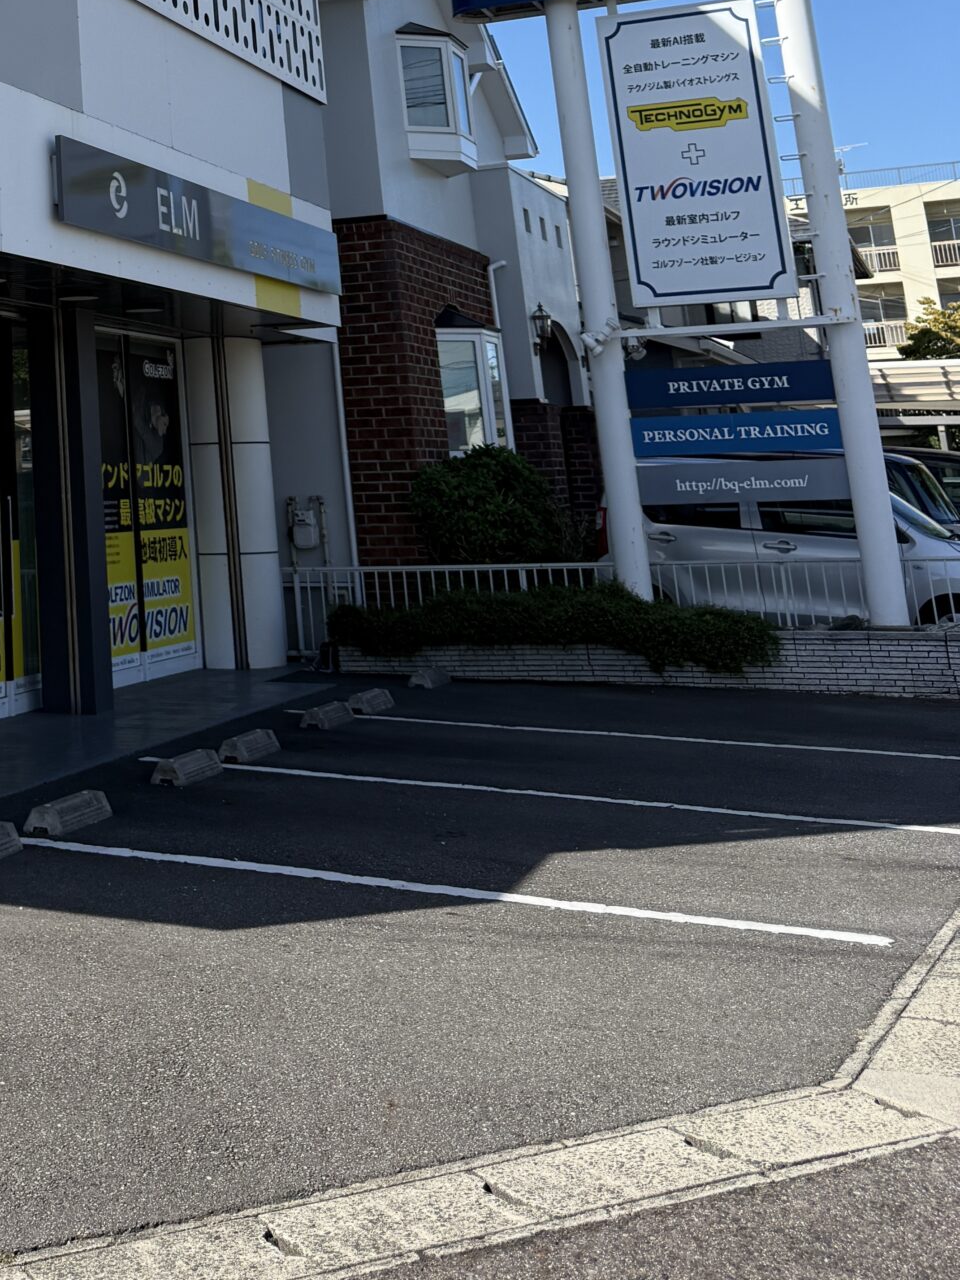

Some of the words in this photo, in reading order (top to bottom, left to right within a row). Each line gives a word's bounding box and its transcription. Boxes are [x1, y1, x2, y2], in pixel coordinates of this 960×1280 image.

[650, 32, 706, 49] 最新AI搭載
[622, 52, 740, 75] 全自動トレーニングマシン
[626, 72, 740, 94] テクノジム製バイオストレングス
[634, 176, 762, 202] TWOVISION
[157, 186, 200, 241] ELM
[665, 210, 740, 226] 最新室内ゴルフ
[652, 232, 760, 249] ラウンドシミュレーター
[651, 252, 766, 269] ゴルフゾーン社製ツービジョン
[668, 378, 744, 394] PRIVATE
[747, 376, 789, 390] GYM
[643, 427, 734, 443] PERSONAL
[737, 422, 829, 439] TRAINING
[676, 475, 808, 494] http://bq-elm.com/
[144, 578, 180, 598] IMULATOR
